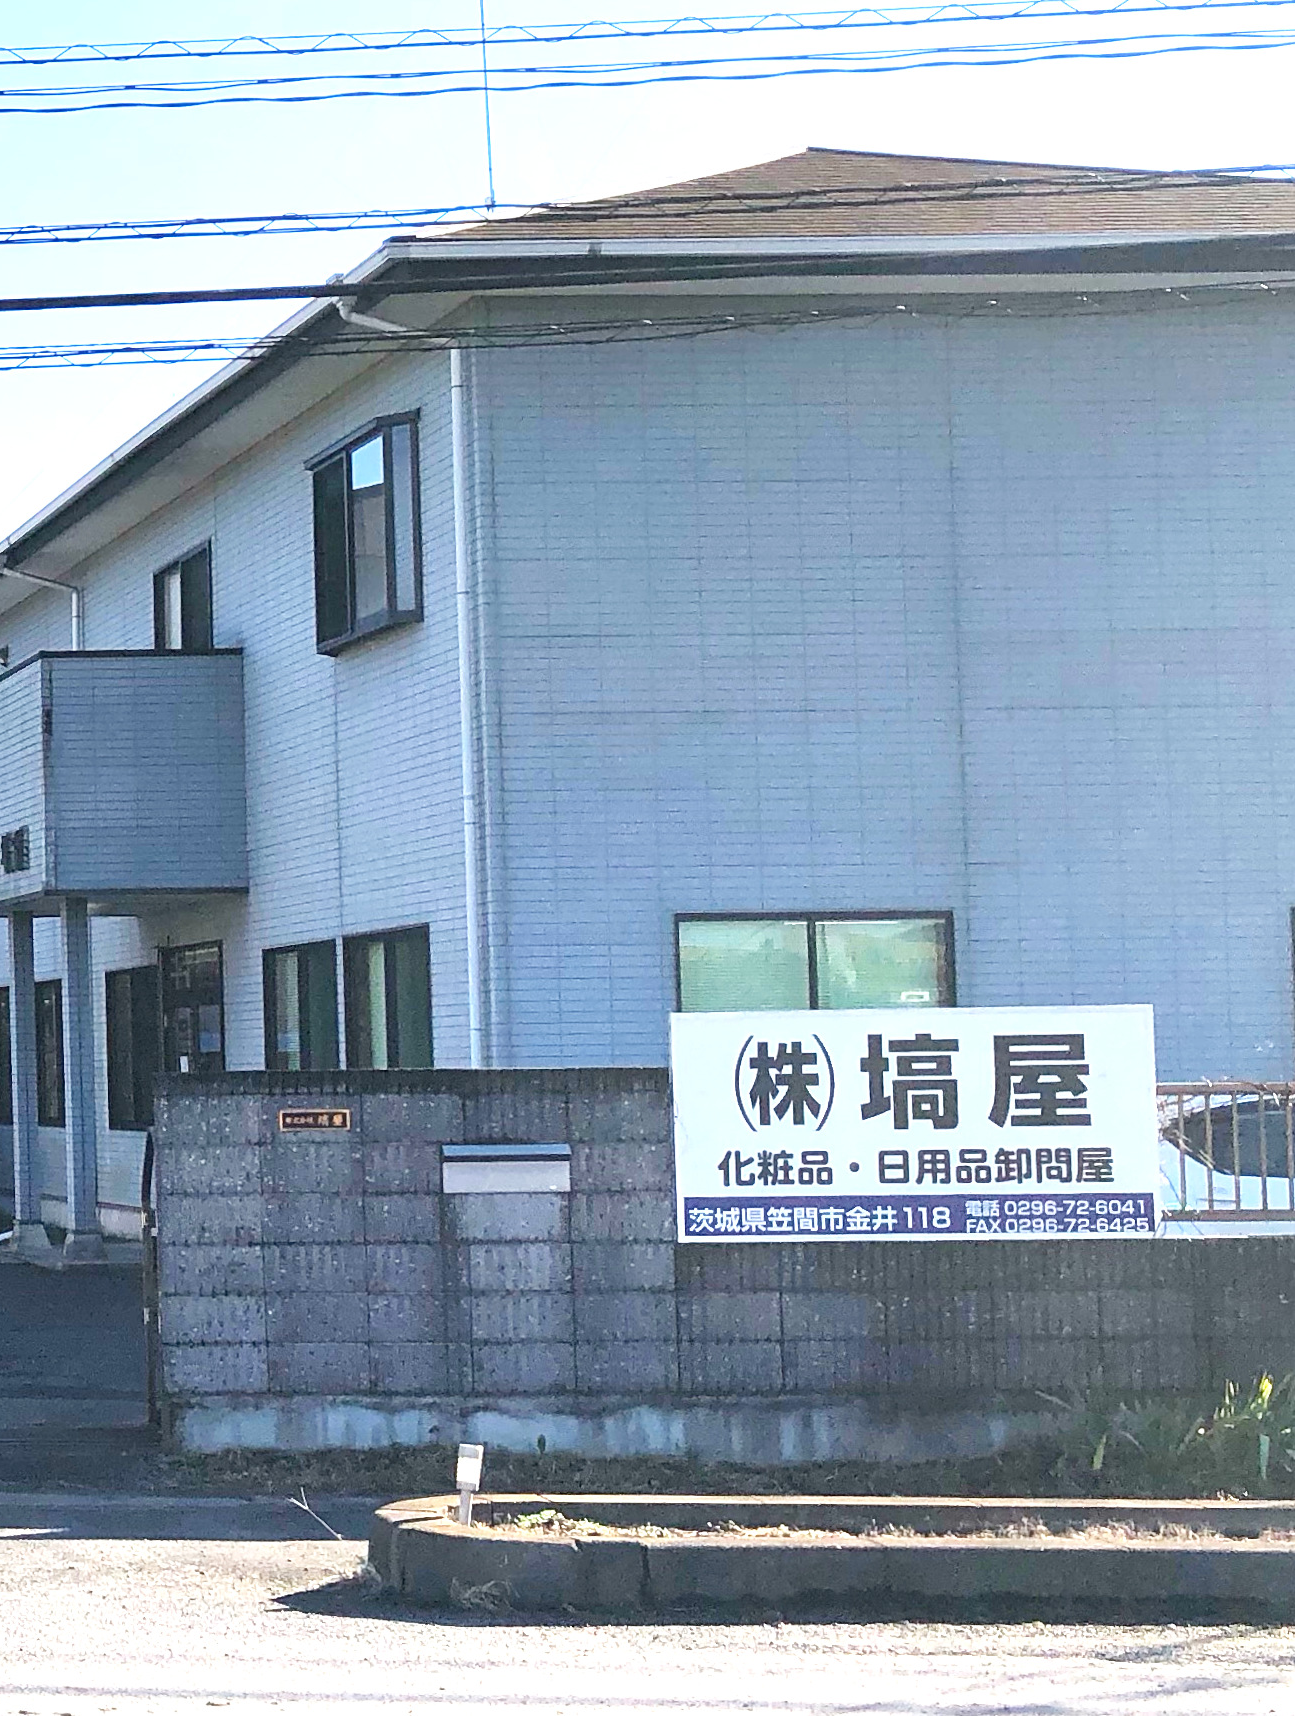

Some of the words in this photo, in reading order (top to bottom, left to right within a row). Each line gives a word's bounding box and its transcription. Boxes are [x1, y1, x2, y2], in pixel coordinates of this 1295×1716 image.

[717, 1147, 1115, 1186] 化粧品・日用品卸問屋
[965, 1200, 1000, 1217] 電話
[1004, 1199, 1146, 1216] 0296-72-6041
[966, 1218, 1001, 1233] FAX
[1005, 1217, 1149, 1233] 0296-72-6425
